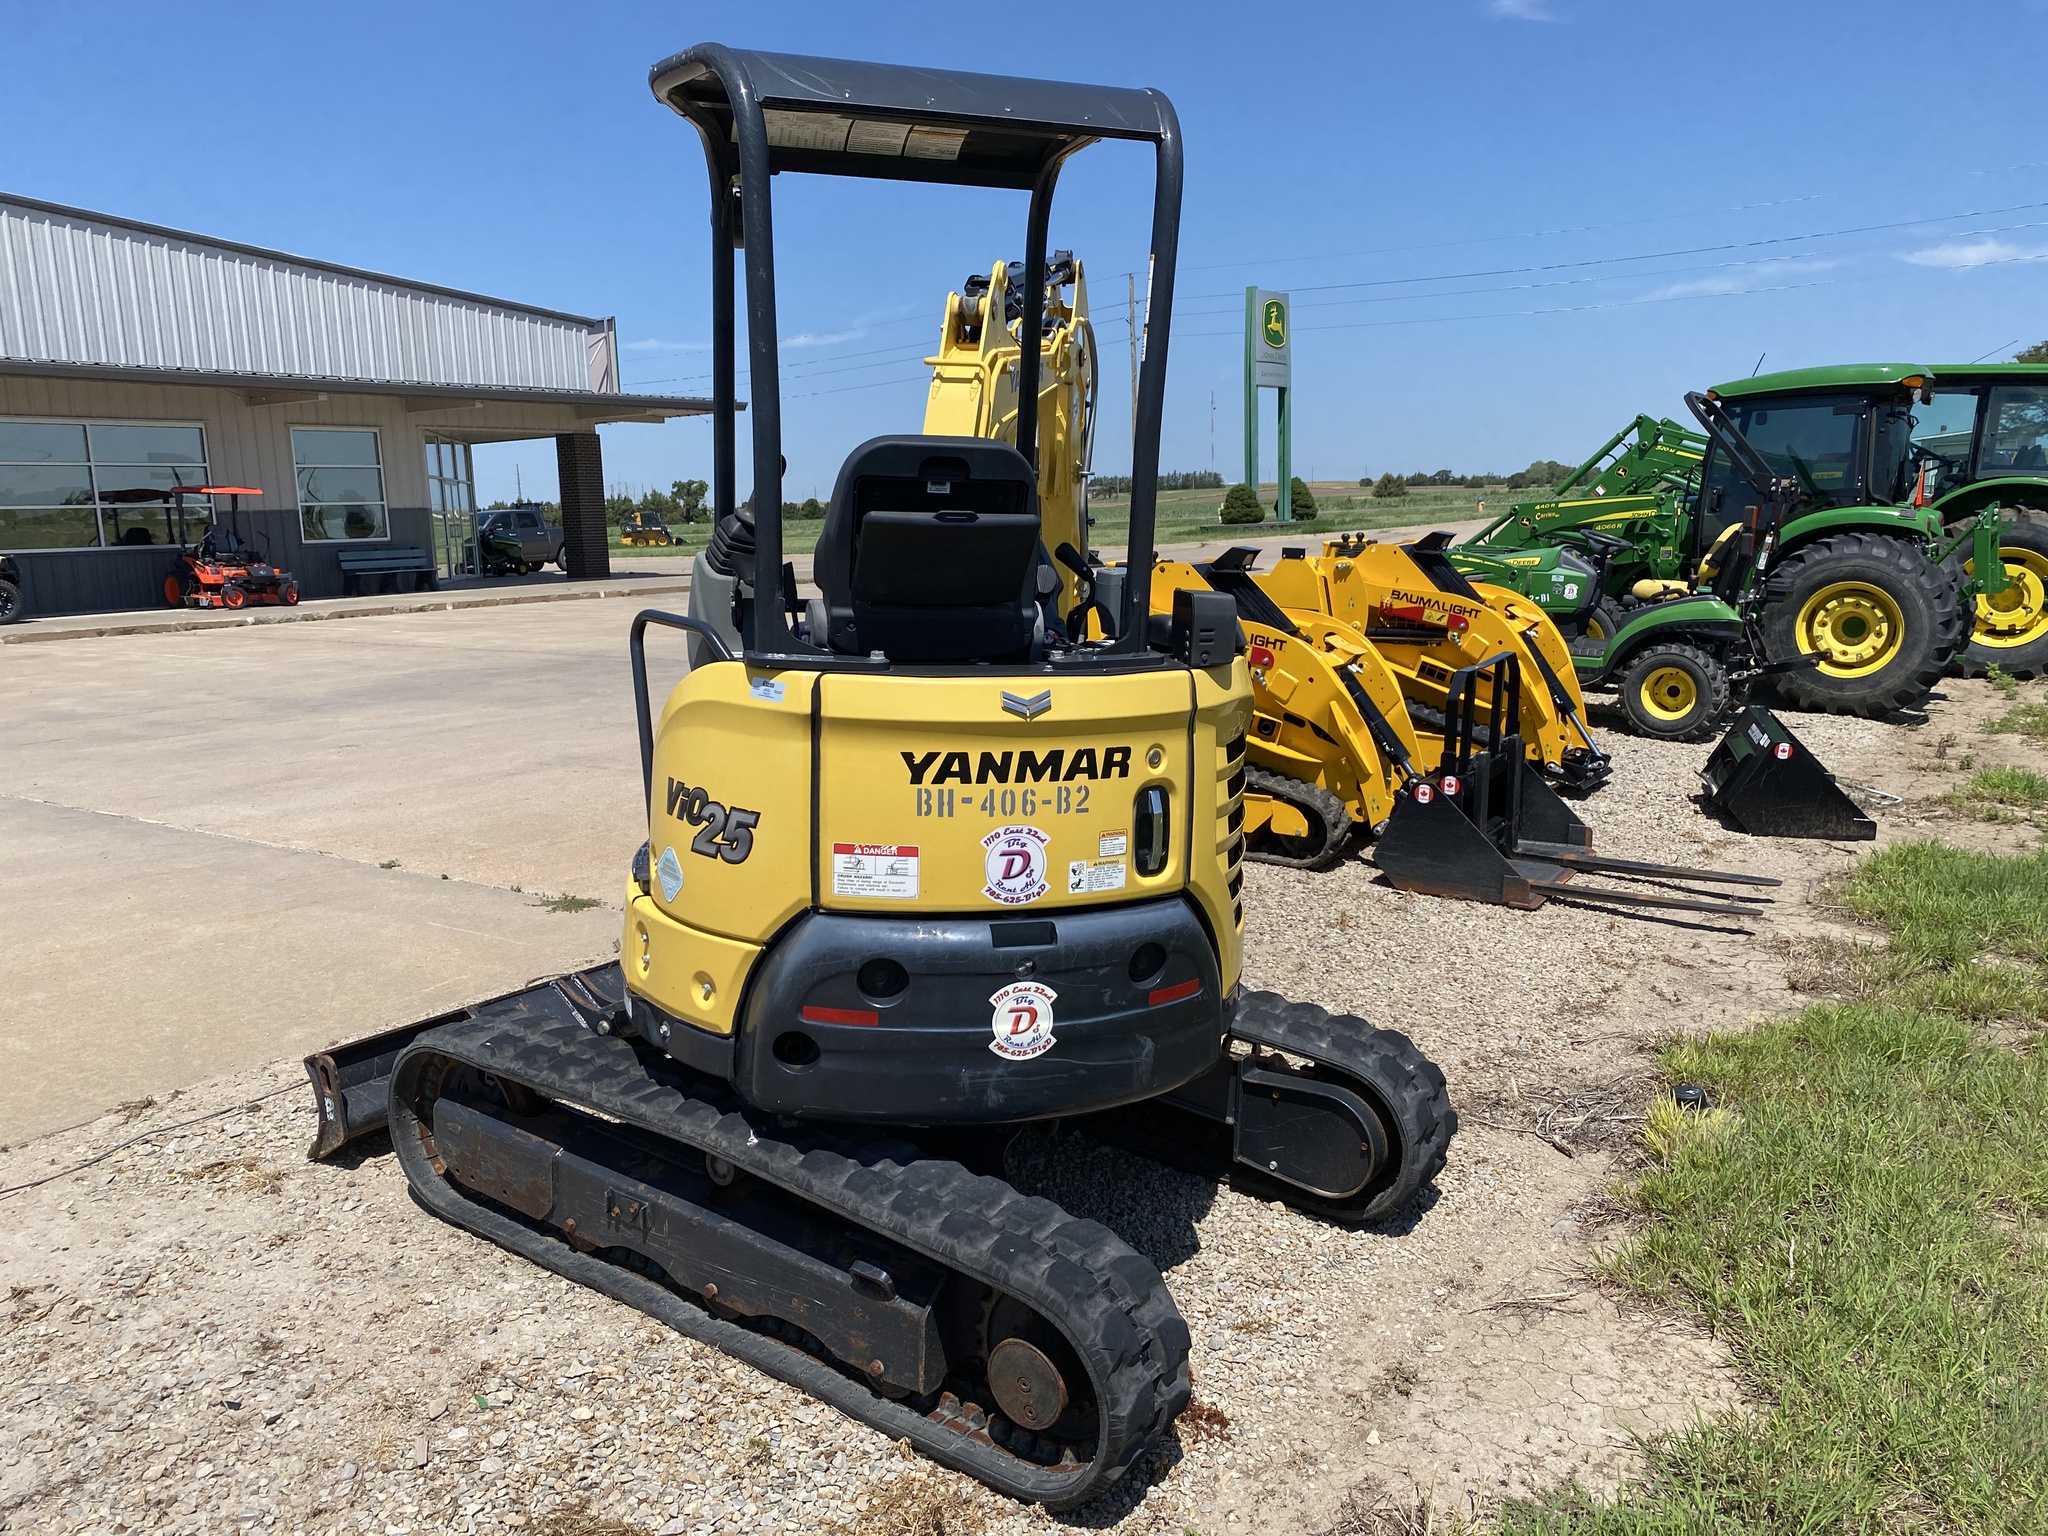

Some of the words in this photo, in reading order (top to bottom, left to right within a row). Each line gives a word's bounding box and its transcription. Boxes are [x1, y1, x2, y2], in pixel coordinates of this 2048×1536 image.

[1391, 589, 1482, 619] BAUMALIGHT
[900, 746, 1132, 785] YANMAR
[916, 785, 1090, 817] BH-406-B2
[1003, 827, 1024, 835] East
[1025, 828, 1047, 844] 22nd
[1004, 838, 1028, 848] Big
[995, 879, 1017, 893] Rent
[1020, 878, 1036, 892] All
[1013, 996, 1035, 1005] Big
[1033, 986, 1054, 1001] 22nd
[1003, 1034, 1025, 1047] Rent
[1027, 1033, 1042, 1046] All
